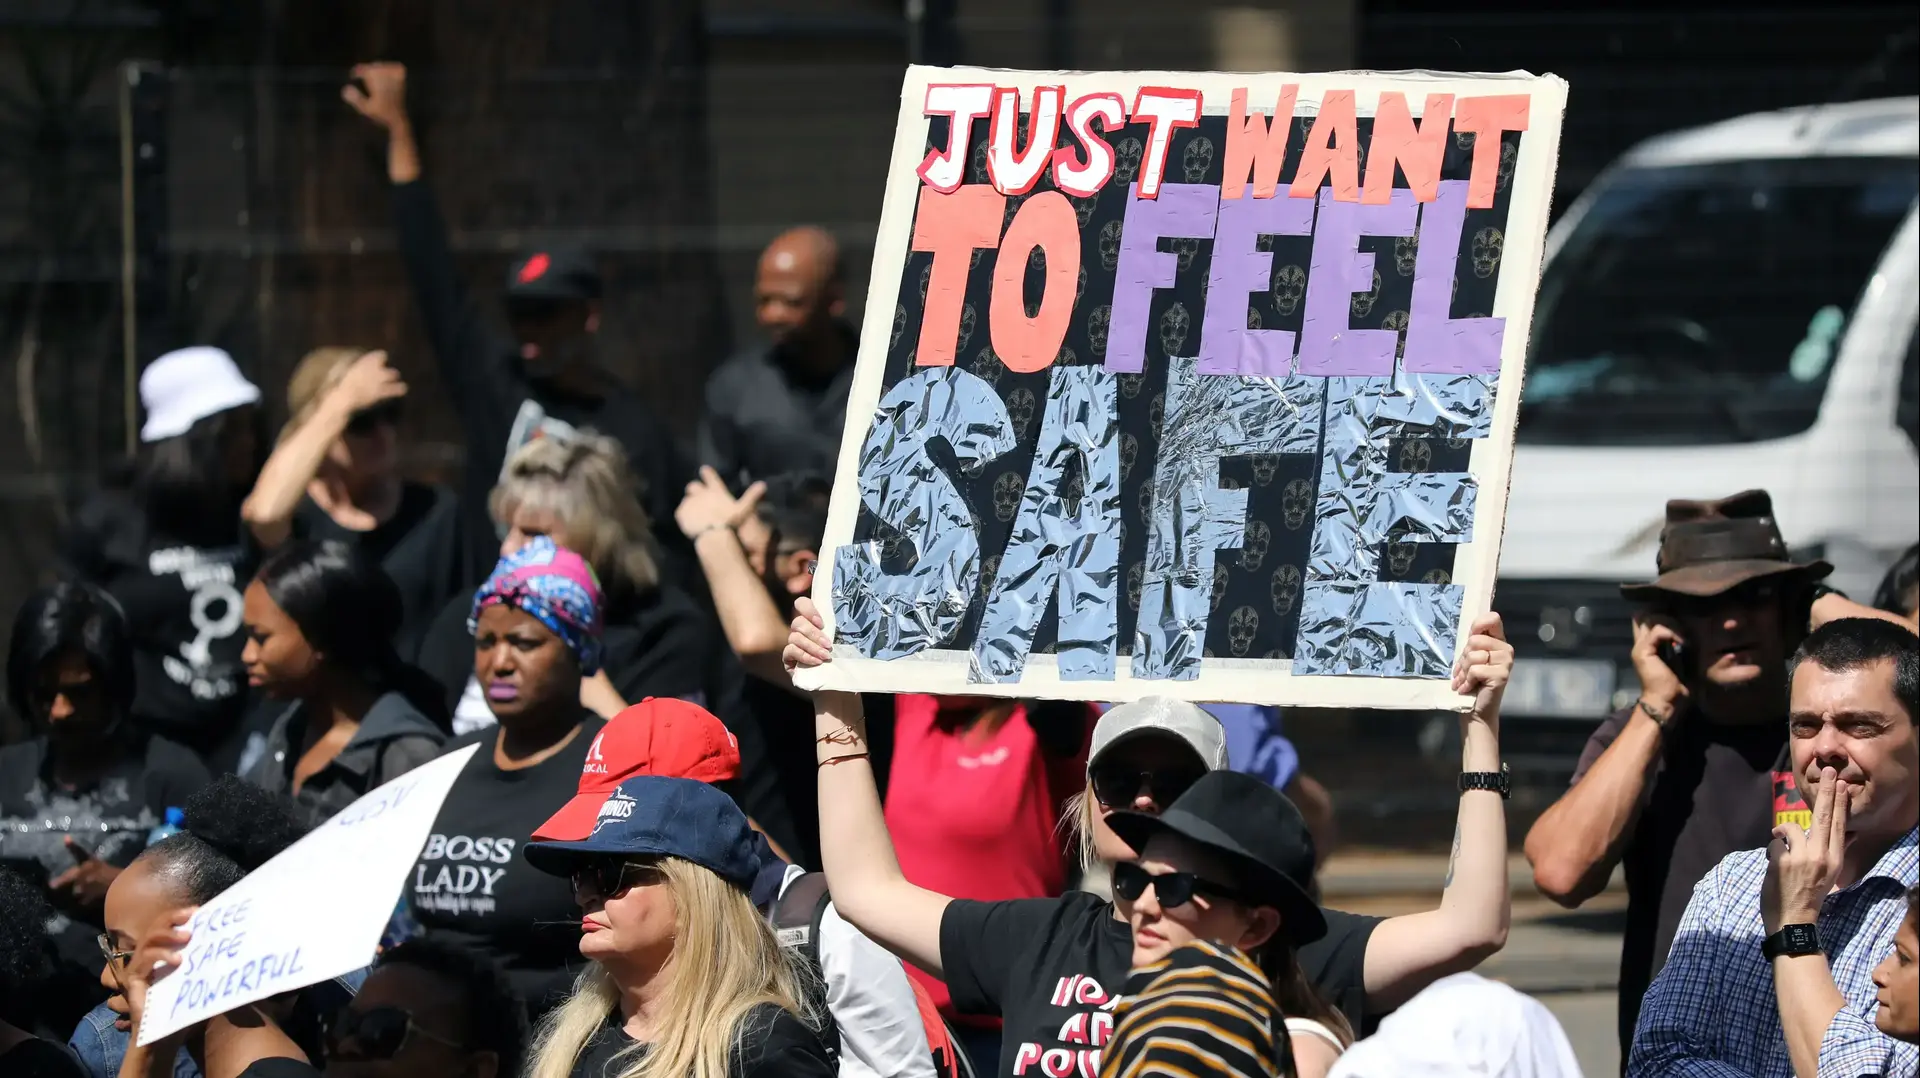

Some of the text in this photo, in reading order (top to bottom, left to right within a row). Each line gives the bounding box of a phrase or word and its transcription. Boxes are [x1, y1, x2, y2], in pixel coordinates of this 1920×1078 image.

[917, 83, 1530, 208] JUST WANT
[911, 180, 1506, 377] TO FEEL
[832, 357, 1502, 684] SAFE
[421, 834, 516, 864] BOSS
[415, 864, 507, 895] LADY
[192, 898, 253, 934] FREE
[170, 945, 304, 1021] POWERFUL
[184, 931, 247, 976] SAFE
